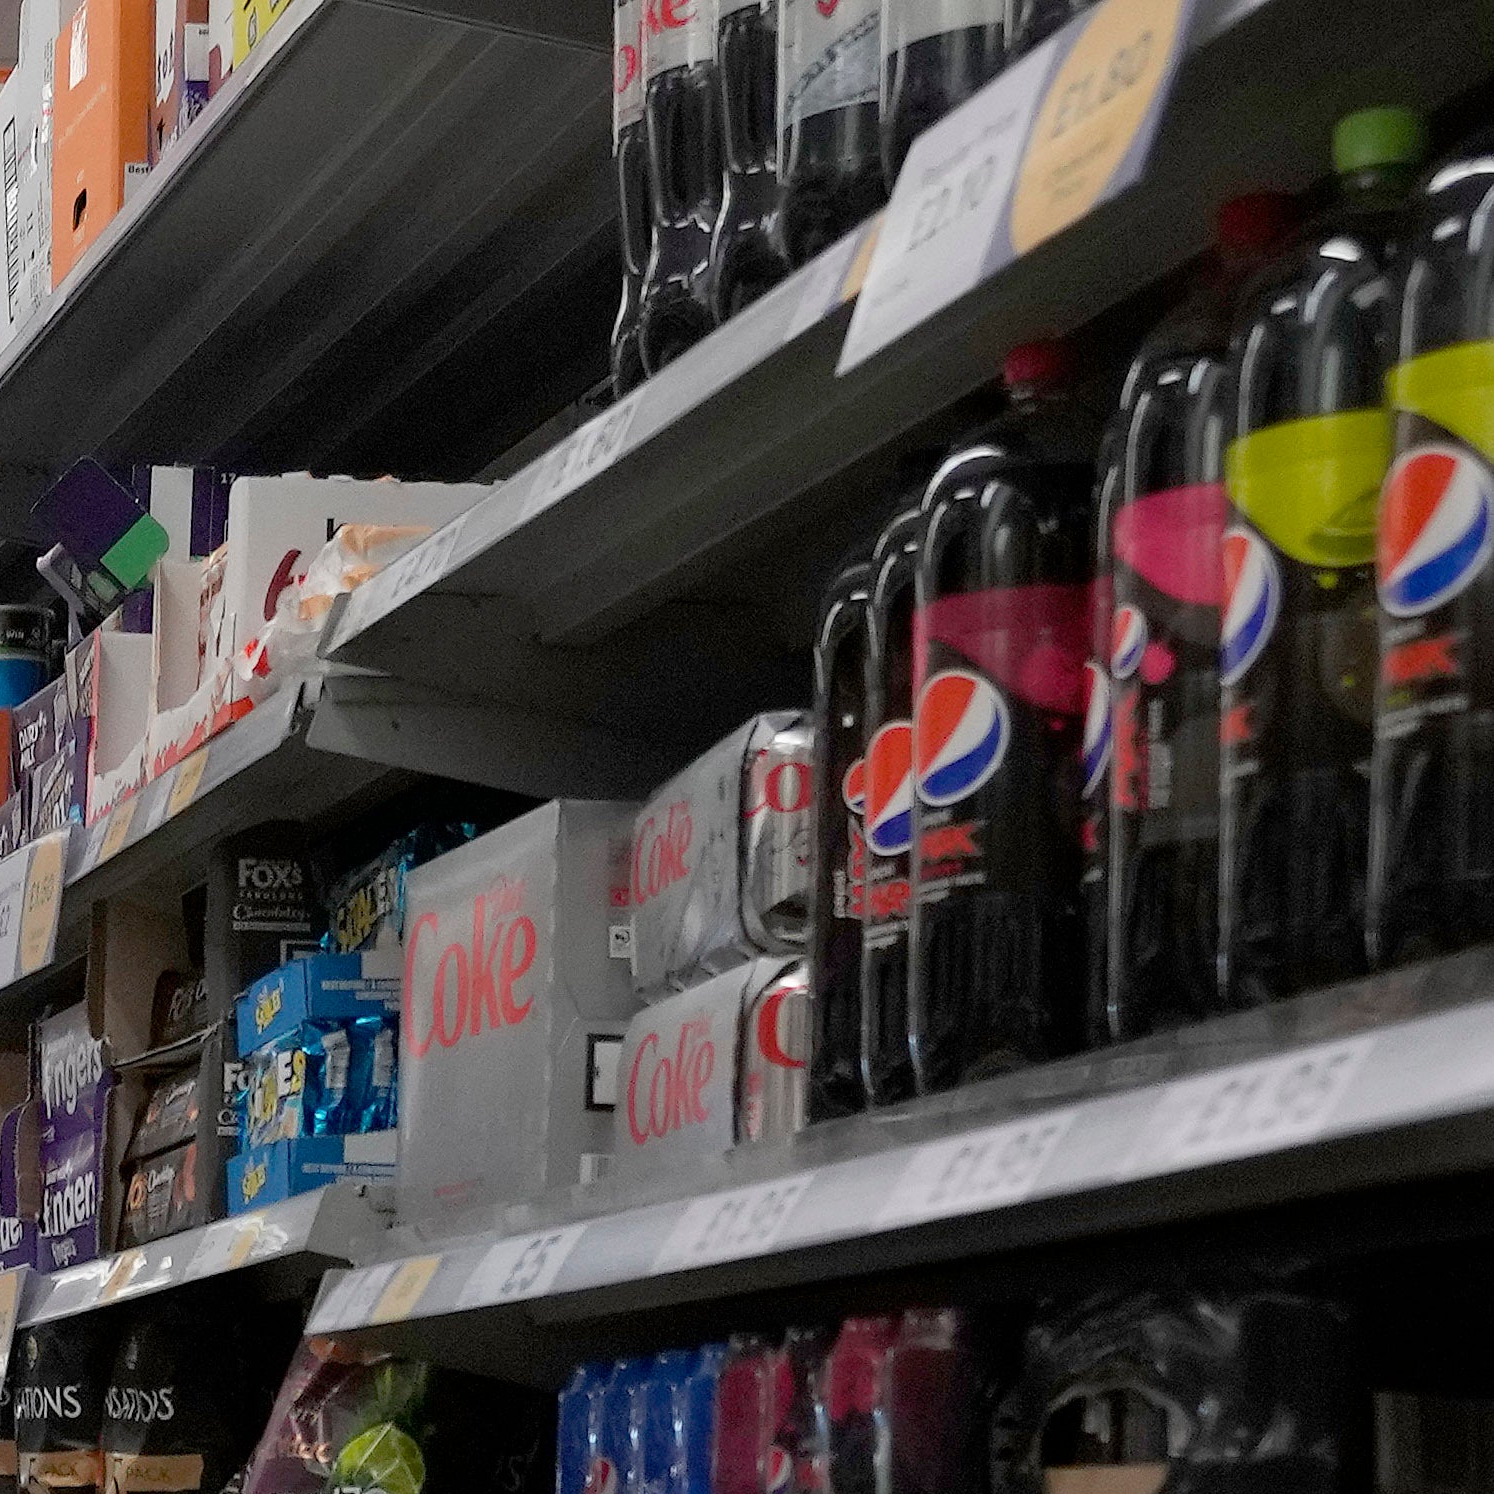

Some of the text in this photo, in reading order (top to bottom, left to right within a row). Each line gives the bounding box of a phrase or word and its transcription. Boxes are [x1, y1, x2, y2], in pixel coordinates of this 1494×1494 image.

[634, 805, 693, 906] Coke
[403, 896, 537, 1059] Coke
[628, 1019, 715, 1145] Coke
[497, 1234, 550, 1293] £5
